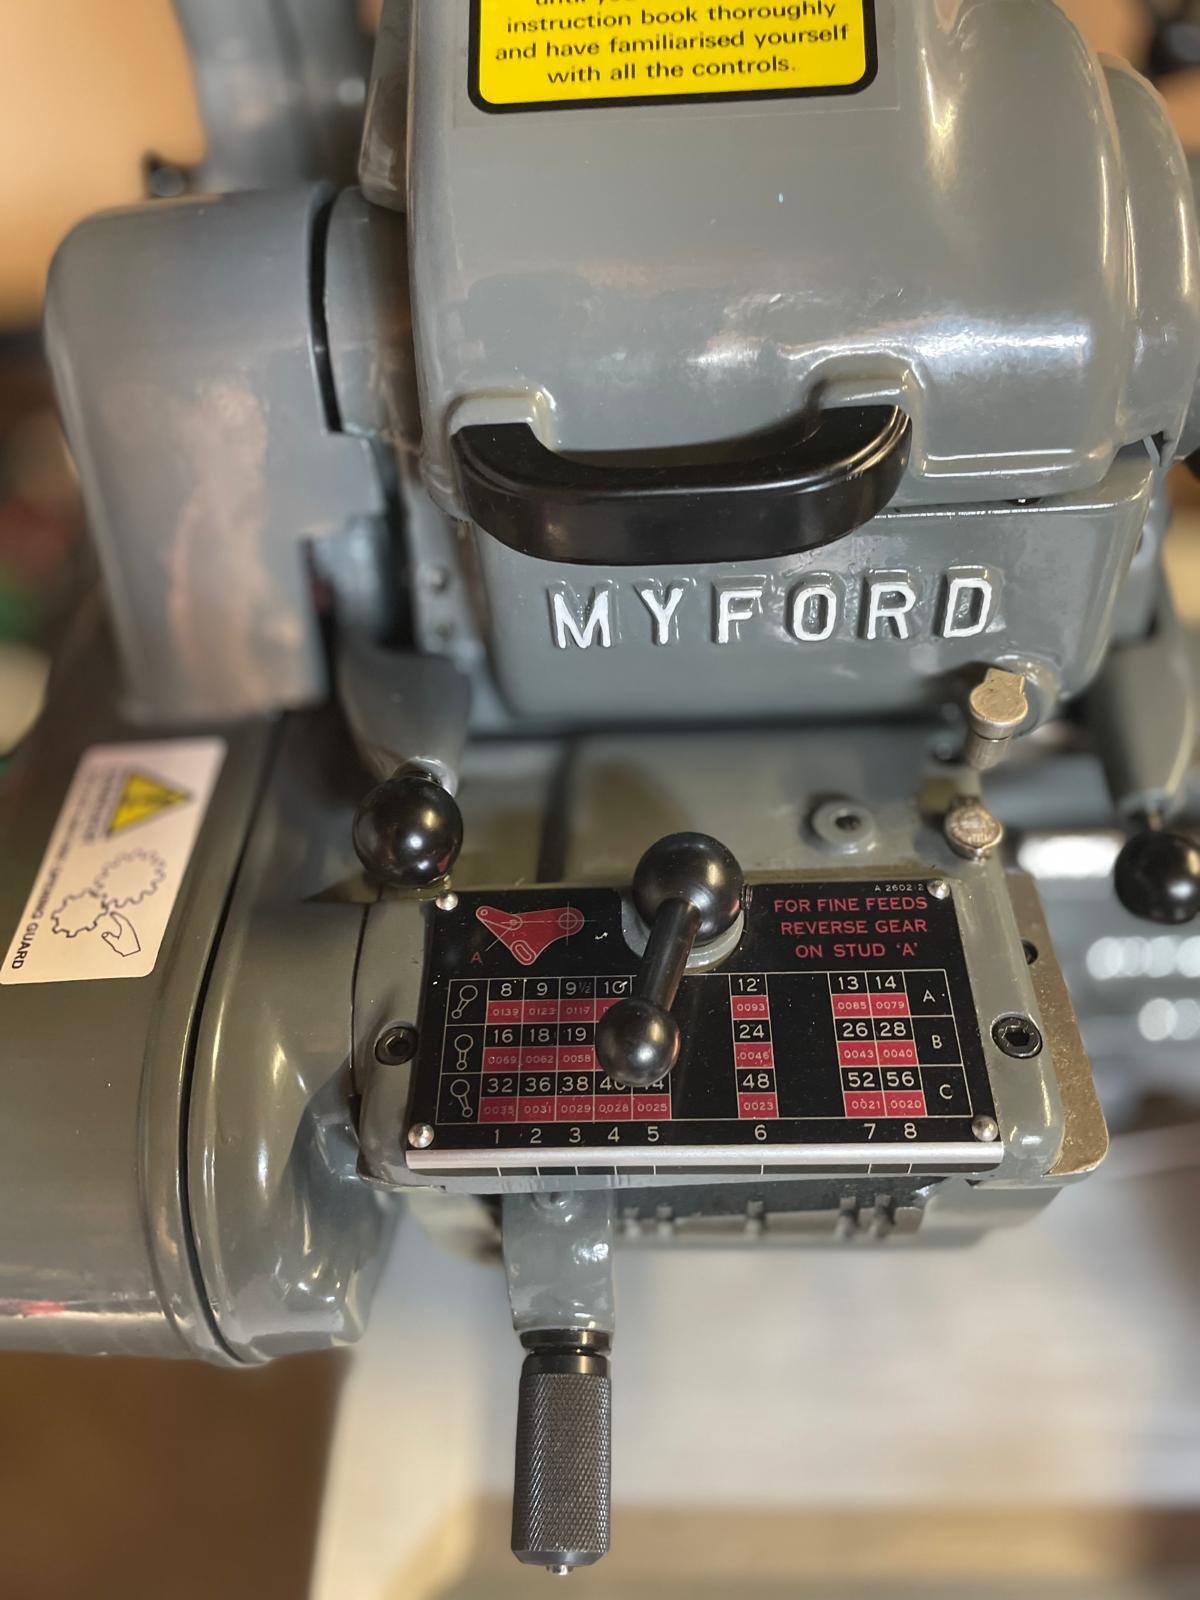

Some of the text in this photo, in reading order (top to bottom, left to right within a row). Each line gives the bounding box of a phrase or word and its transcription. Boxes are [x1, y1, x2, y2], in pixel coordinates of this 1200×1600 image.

[507, 0, 837, 33] instruction book thoroughly
[495, 23, 849, 61] and have familiarised yourself
[547, 65, 601, 84] with
[610, 63, 636, 81] all
[646, 61, 684, 79] the
[550, 576, 994, 650] MYFORD
[886, 884, 913, 892] 2602
[773, 896, 928, 913] FOR FINE FEEDS
[781, 918, 928, 936] REVERSE GEAR
[11, 922, 39, 970] GUARD
[795, 944, 823, 959] ON
[833, 943, 886, 958] STUD
[470, 951, 481, 964] A
[500, 982, 512, 997] 8
[536, 982, 548, 996] 9
[604, 980, 626, 995] 10
[738, 977, 758, 992] 12
[838, 975, 897, 991] 13 14
[922, 989, 936, 1003] A
[494, 1027, 587, 1043] 16 18 19
[739, 1024, 765, 1039] 24
[842, 1021, 907, 1037] 26 28
[931, 1034, 943, 1049] B
[487, 1078, 513, 1093] 32
[525, 1077, 550, 1092] 36
[562, 1076, 589, 1092] 38
[742, 1073, 770, 1089] 48
[848, 1071, 914, 1088] 52 56
[939, 1084, 953, 1100] C
[494, 1126, 660, 1144] 1 2 3 4 5
[754, 1124, 767, 1141] 6
[863, 1122, 917, 1140] 7 8
